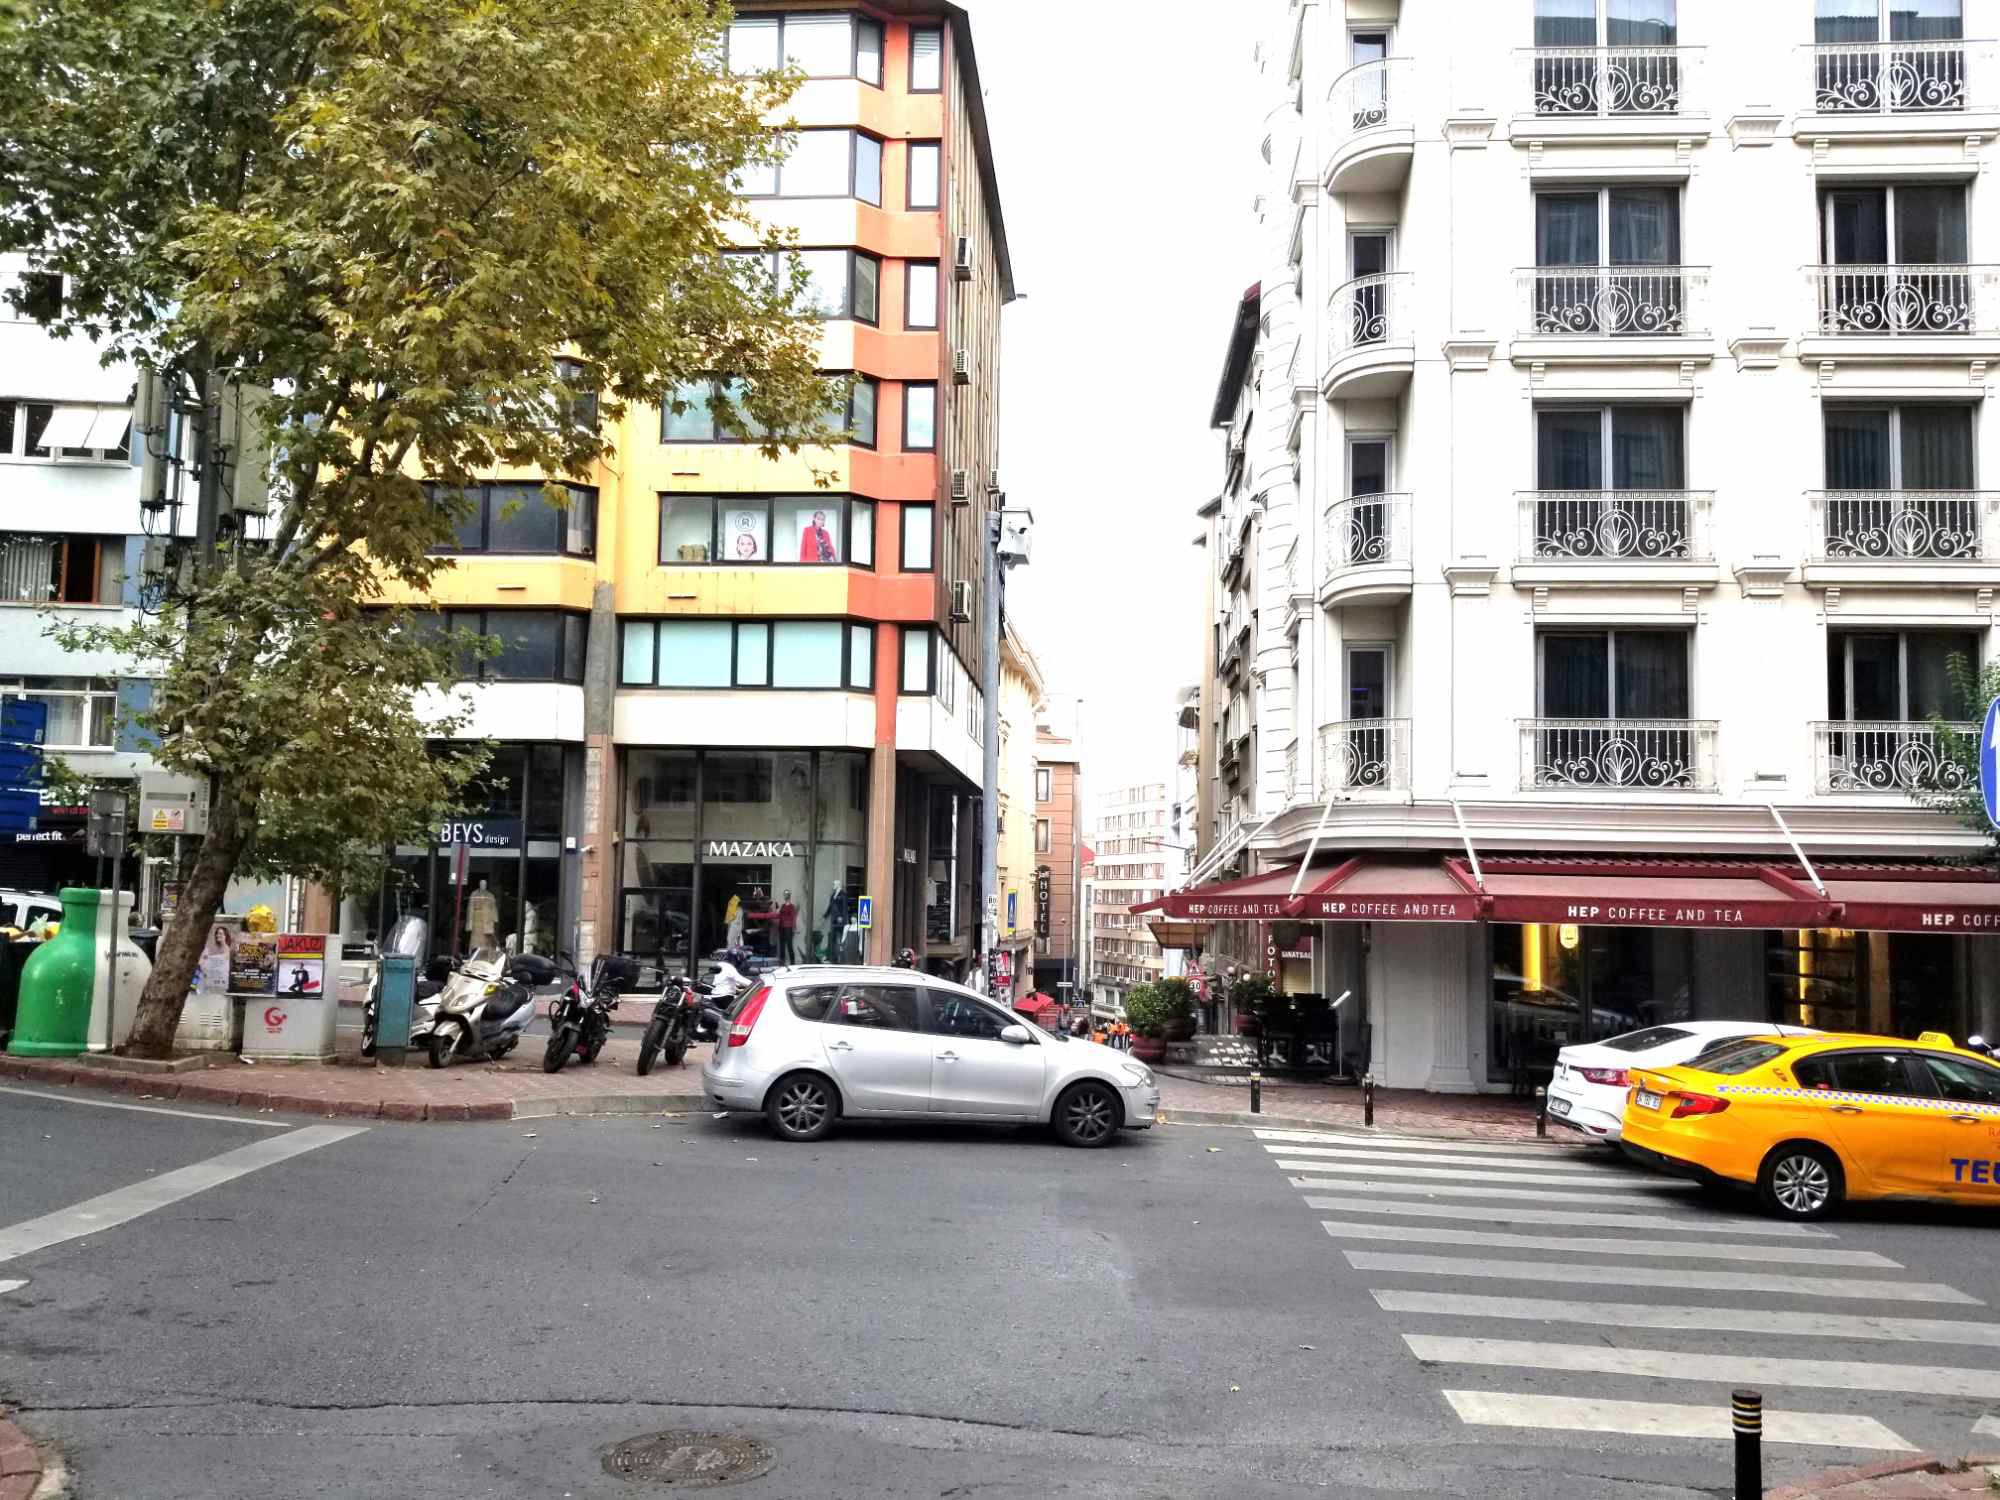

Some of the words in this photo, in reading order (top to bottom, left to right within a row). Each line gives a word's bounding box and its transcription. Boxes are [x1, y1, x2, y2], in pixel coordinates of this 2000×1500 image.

[441, 823, 484, 843] BEYS
[485, 834, 509, 845] design
[709, 841, 794, 857] MAZAKA
[1039, 881, 1048, 934] HOTEL
[1189, 903, 1205, 914] HEP
[1207, 904, 1239, 915] COFFEE
[1242, 904, 1259, 915] AND
[1263, 904, 1280, 915] TEA
[1322, 902, 1346, 913] HEP
[1351, 903, 1397, 915] COFFEE
[1403, 904, 1428, 916] AND
[1432, 904, 1456, 916] TEA
[1567, 905, 1600, 918] HEP
[1608, 907, 1666, 921] COFFEE
[1675, 910, 1704, 921] AND
[1714, 910, 1743, 922] TEA
[1922, 913, 1955, 926] HEP
